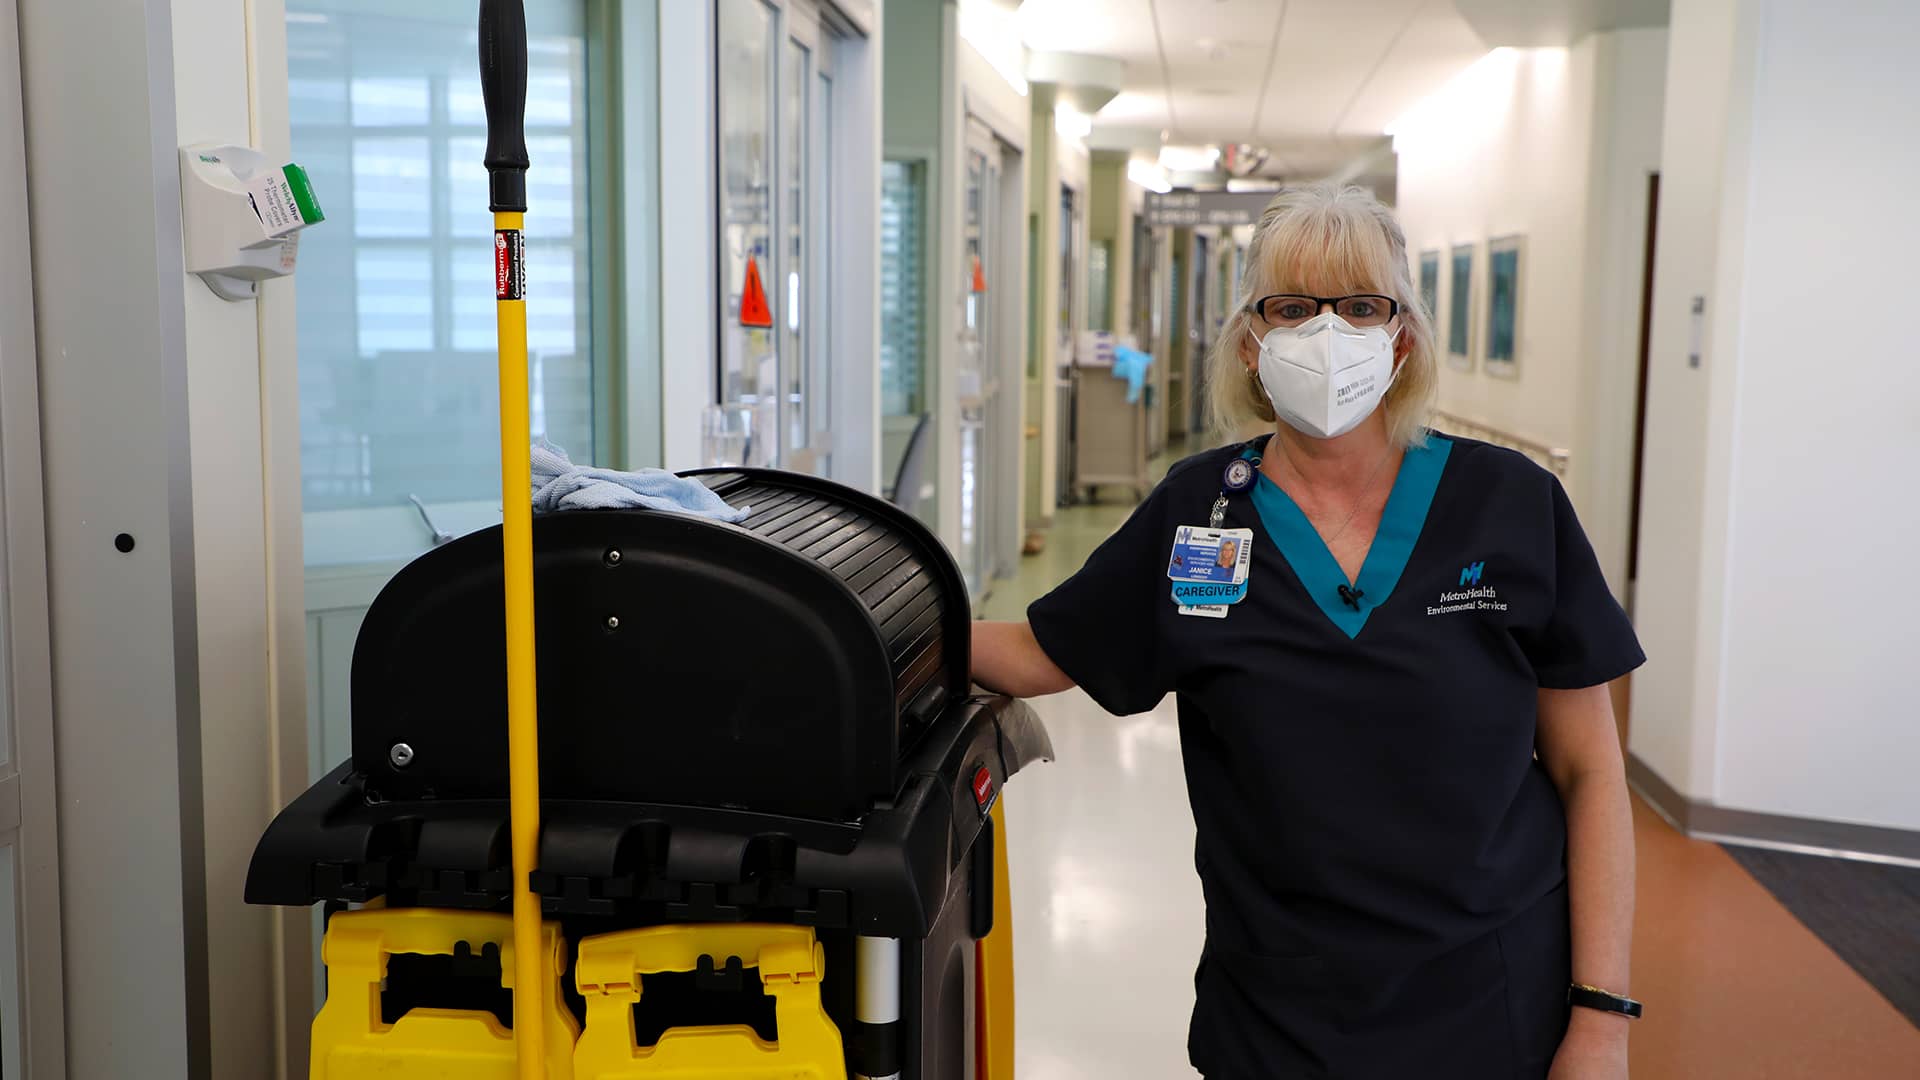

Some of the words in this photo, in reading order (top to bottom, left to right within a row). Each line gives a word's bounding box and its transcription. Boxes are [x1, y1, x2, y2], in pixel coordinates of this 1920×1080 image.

[1189, 567, 1212, 575] JANICE
[1175, 586, 1240, 597] CAREGIVER
[1440, 585, 1496, 603] MetroHealth
[1427, 601, 1476, 615] Environmental
[1477, 600, 1508, 611] Services
